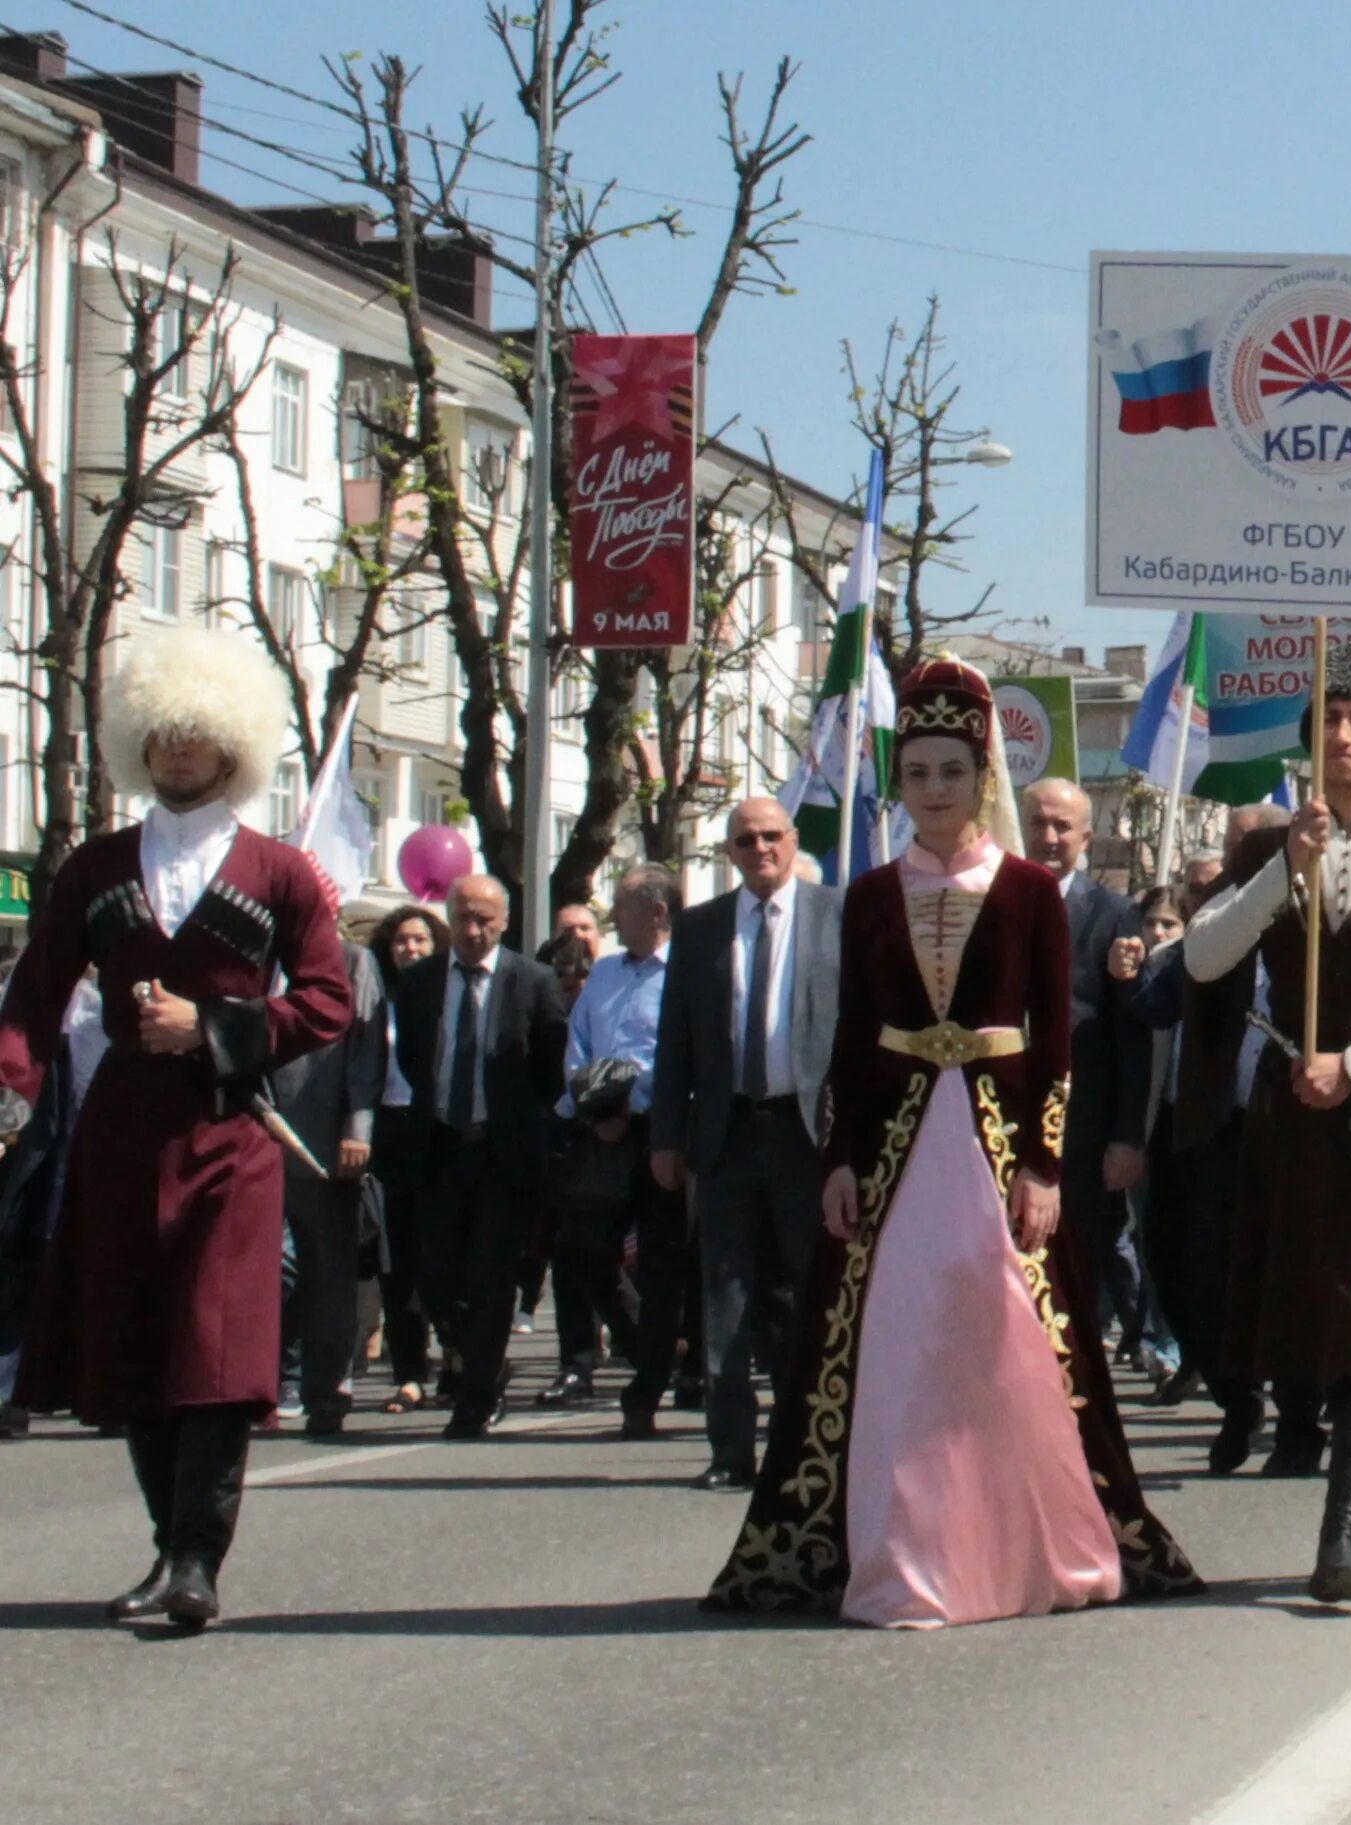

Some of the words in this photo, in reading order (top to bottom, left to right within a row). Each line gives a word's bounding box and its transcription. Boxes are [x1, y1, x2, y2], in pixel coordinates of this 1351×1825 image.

[592, 440, 671, 512] Днём
[568, 482, 687, 570] Победы
[1243, 523, 1345, 549] ФГБОУ
[593, 611, 607, 632] 9
[615, 611, 669, 632] МАЯ
